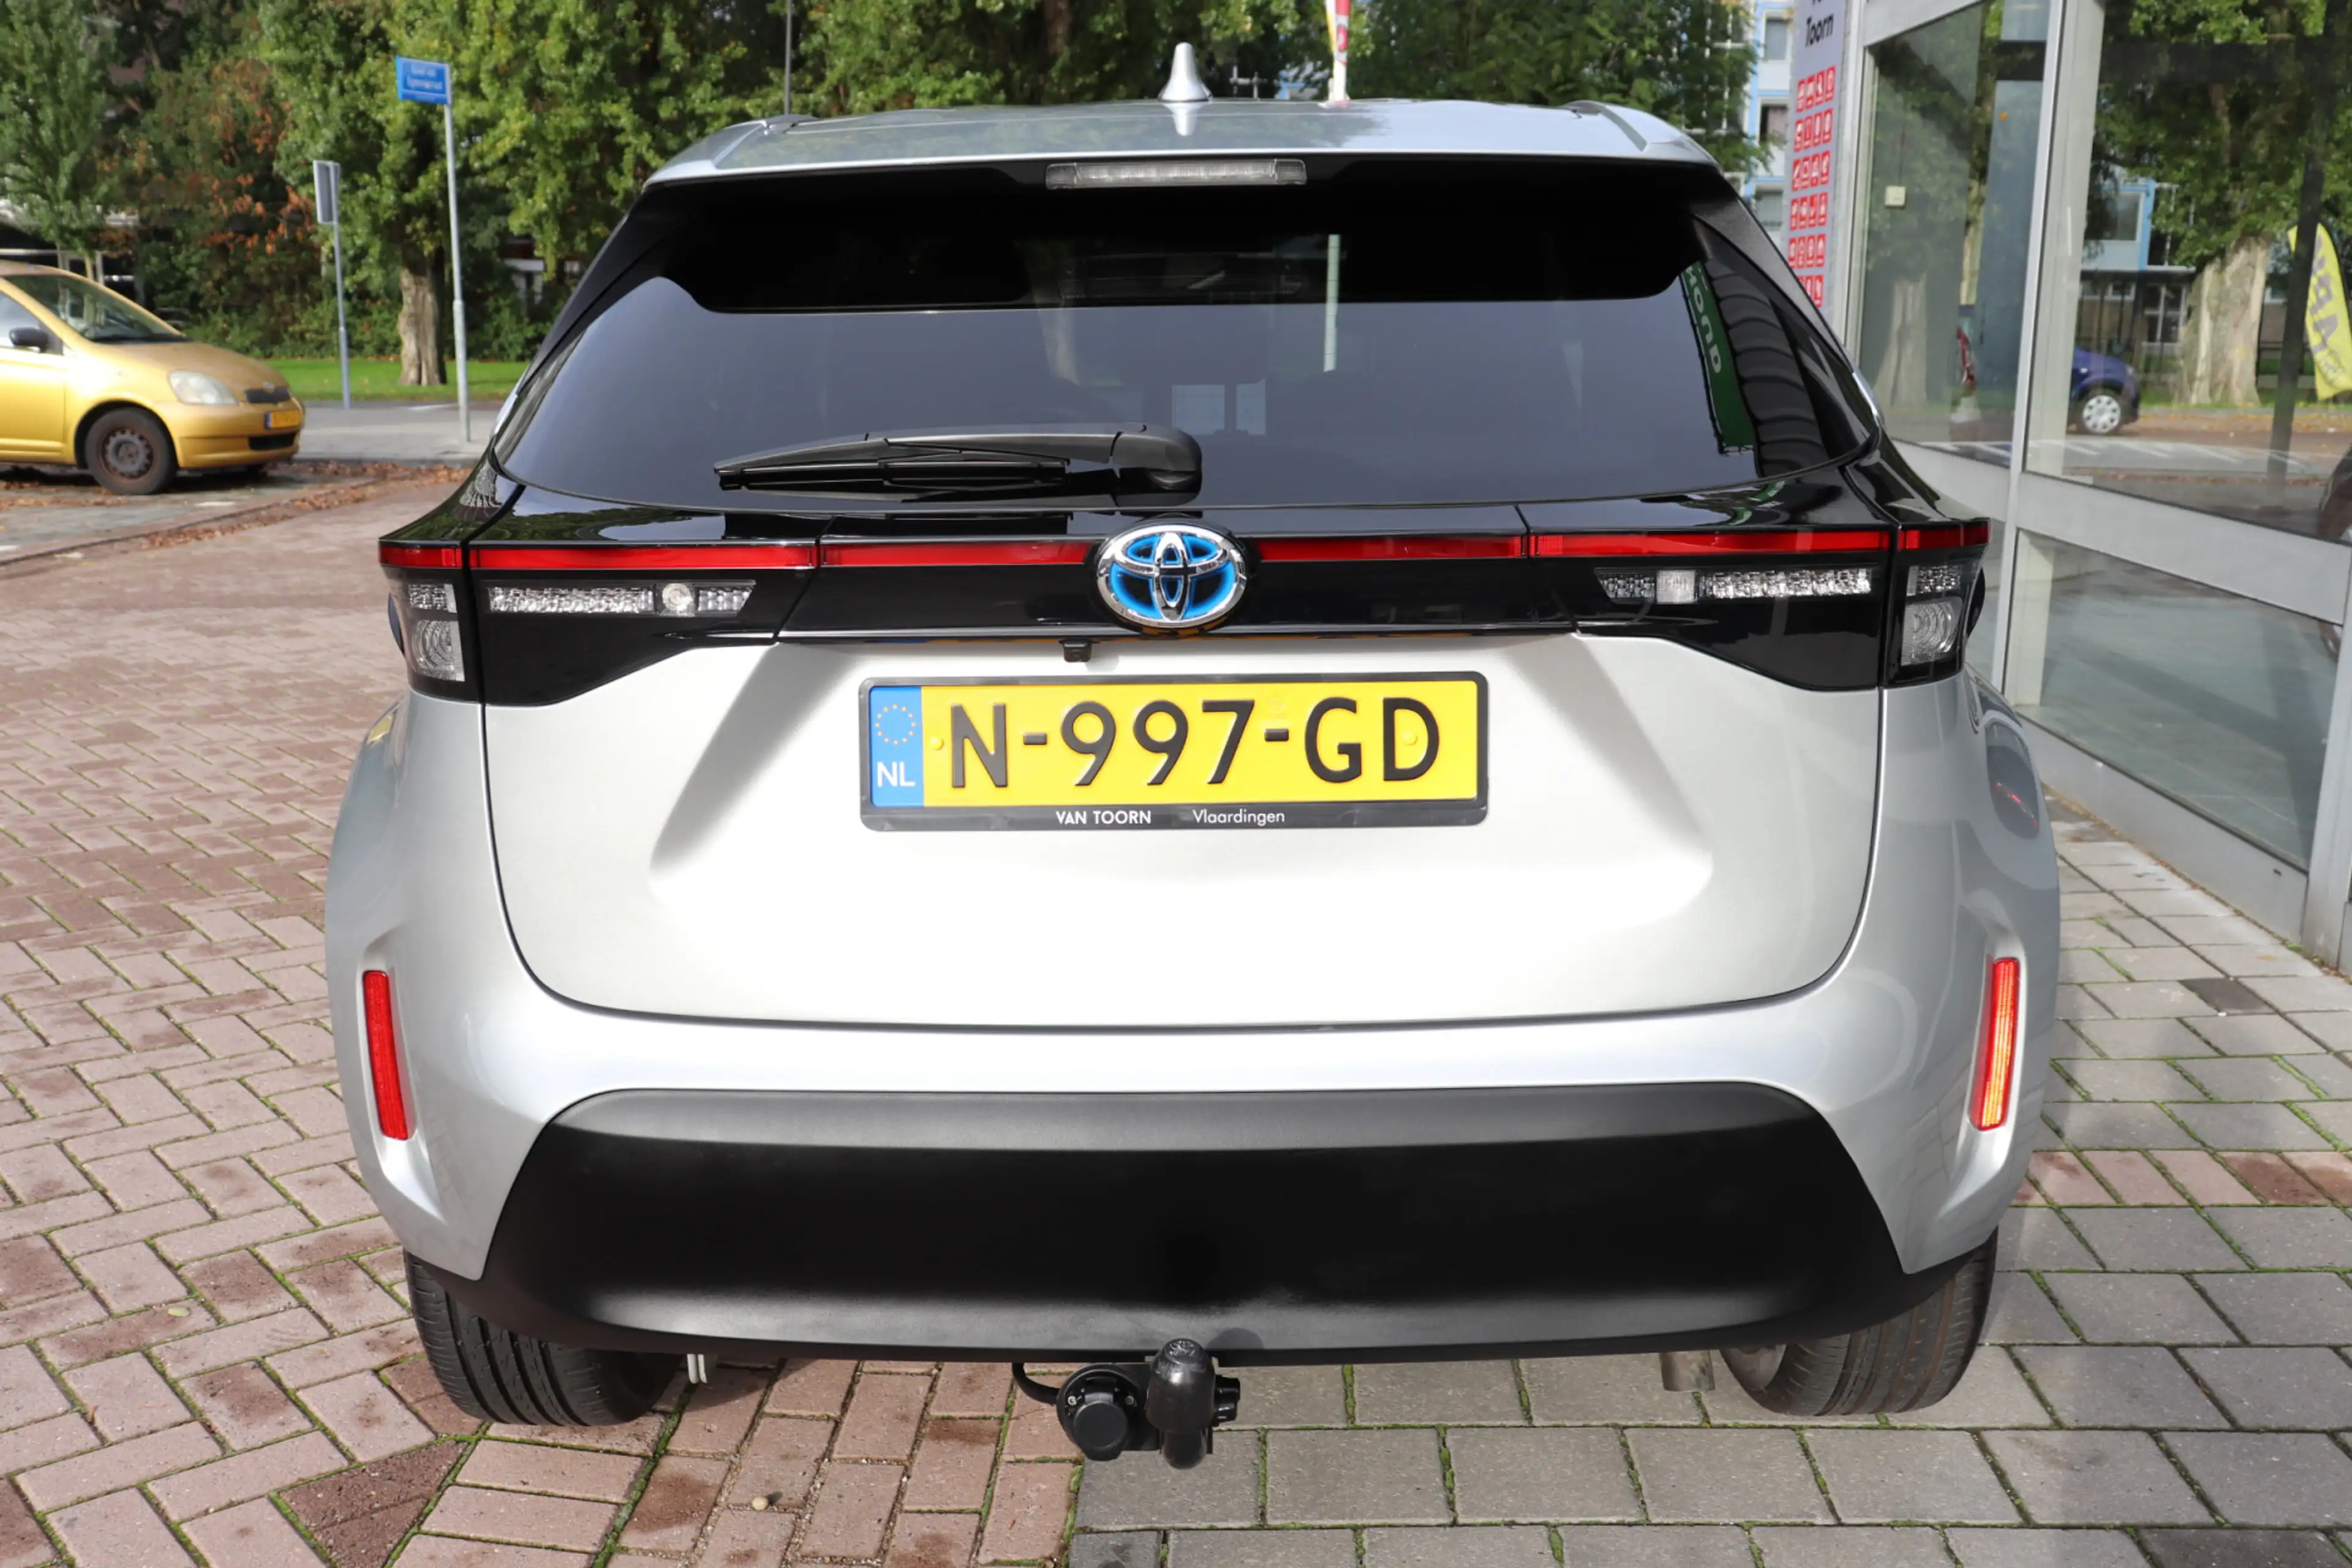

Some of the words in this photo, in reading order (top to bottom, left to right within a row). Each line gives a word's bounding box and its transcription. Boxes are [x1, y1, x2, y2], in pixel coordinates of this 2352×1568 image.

[1805, 14, 1834, 47] Toorn
[950, 696, 1441, 788] N-997-GD
[877, 761, 916, 788] NL
[1055, 810, 1087, 825] VAN
[1093, 810, 1152, 824] TOORN
[1192, 808, 1286, 827] Vlaardingen
